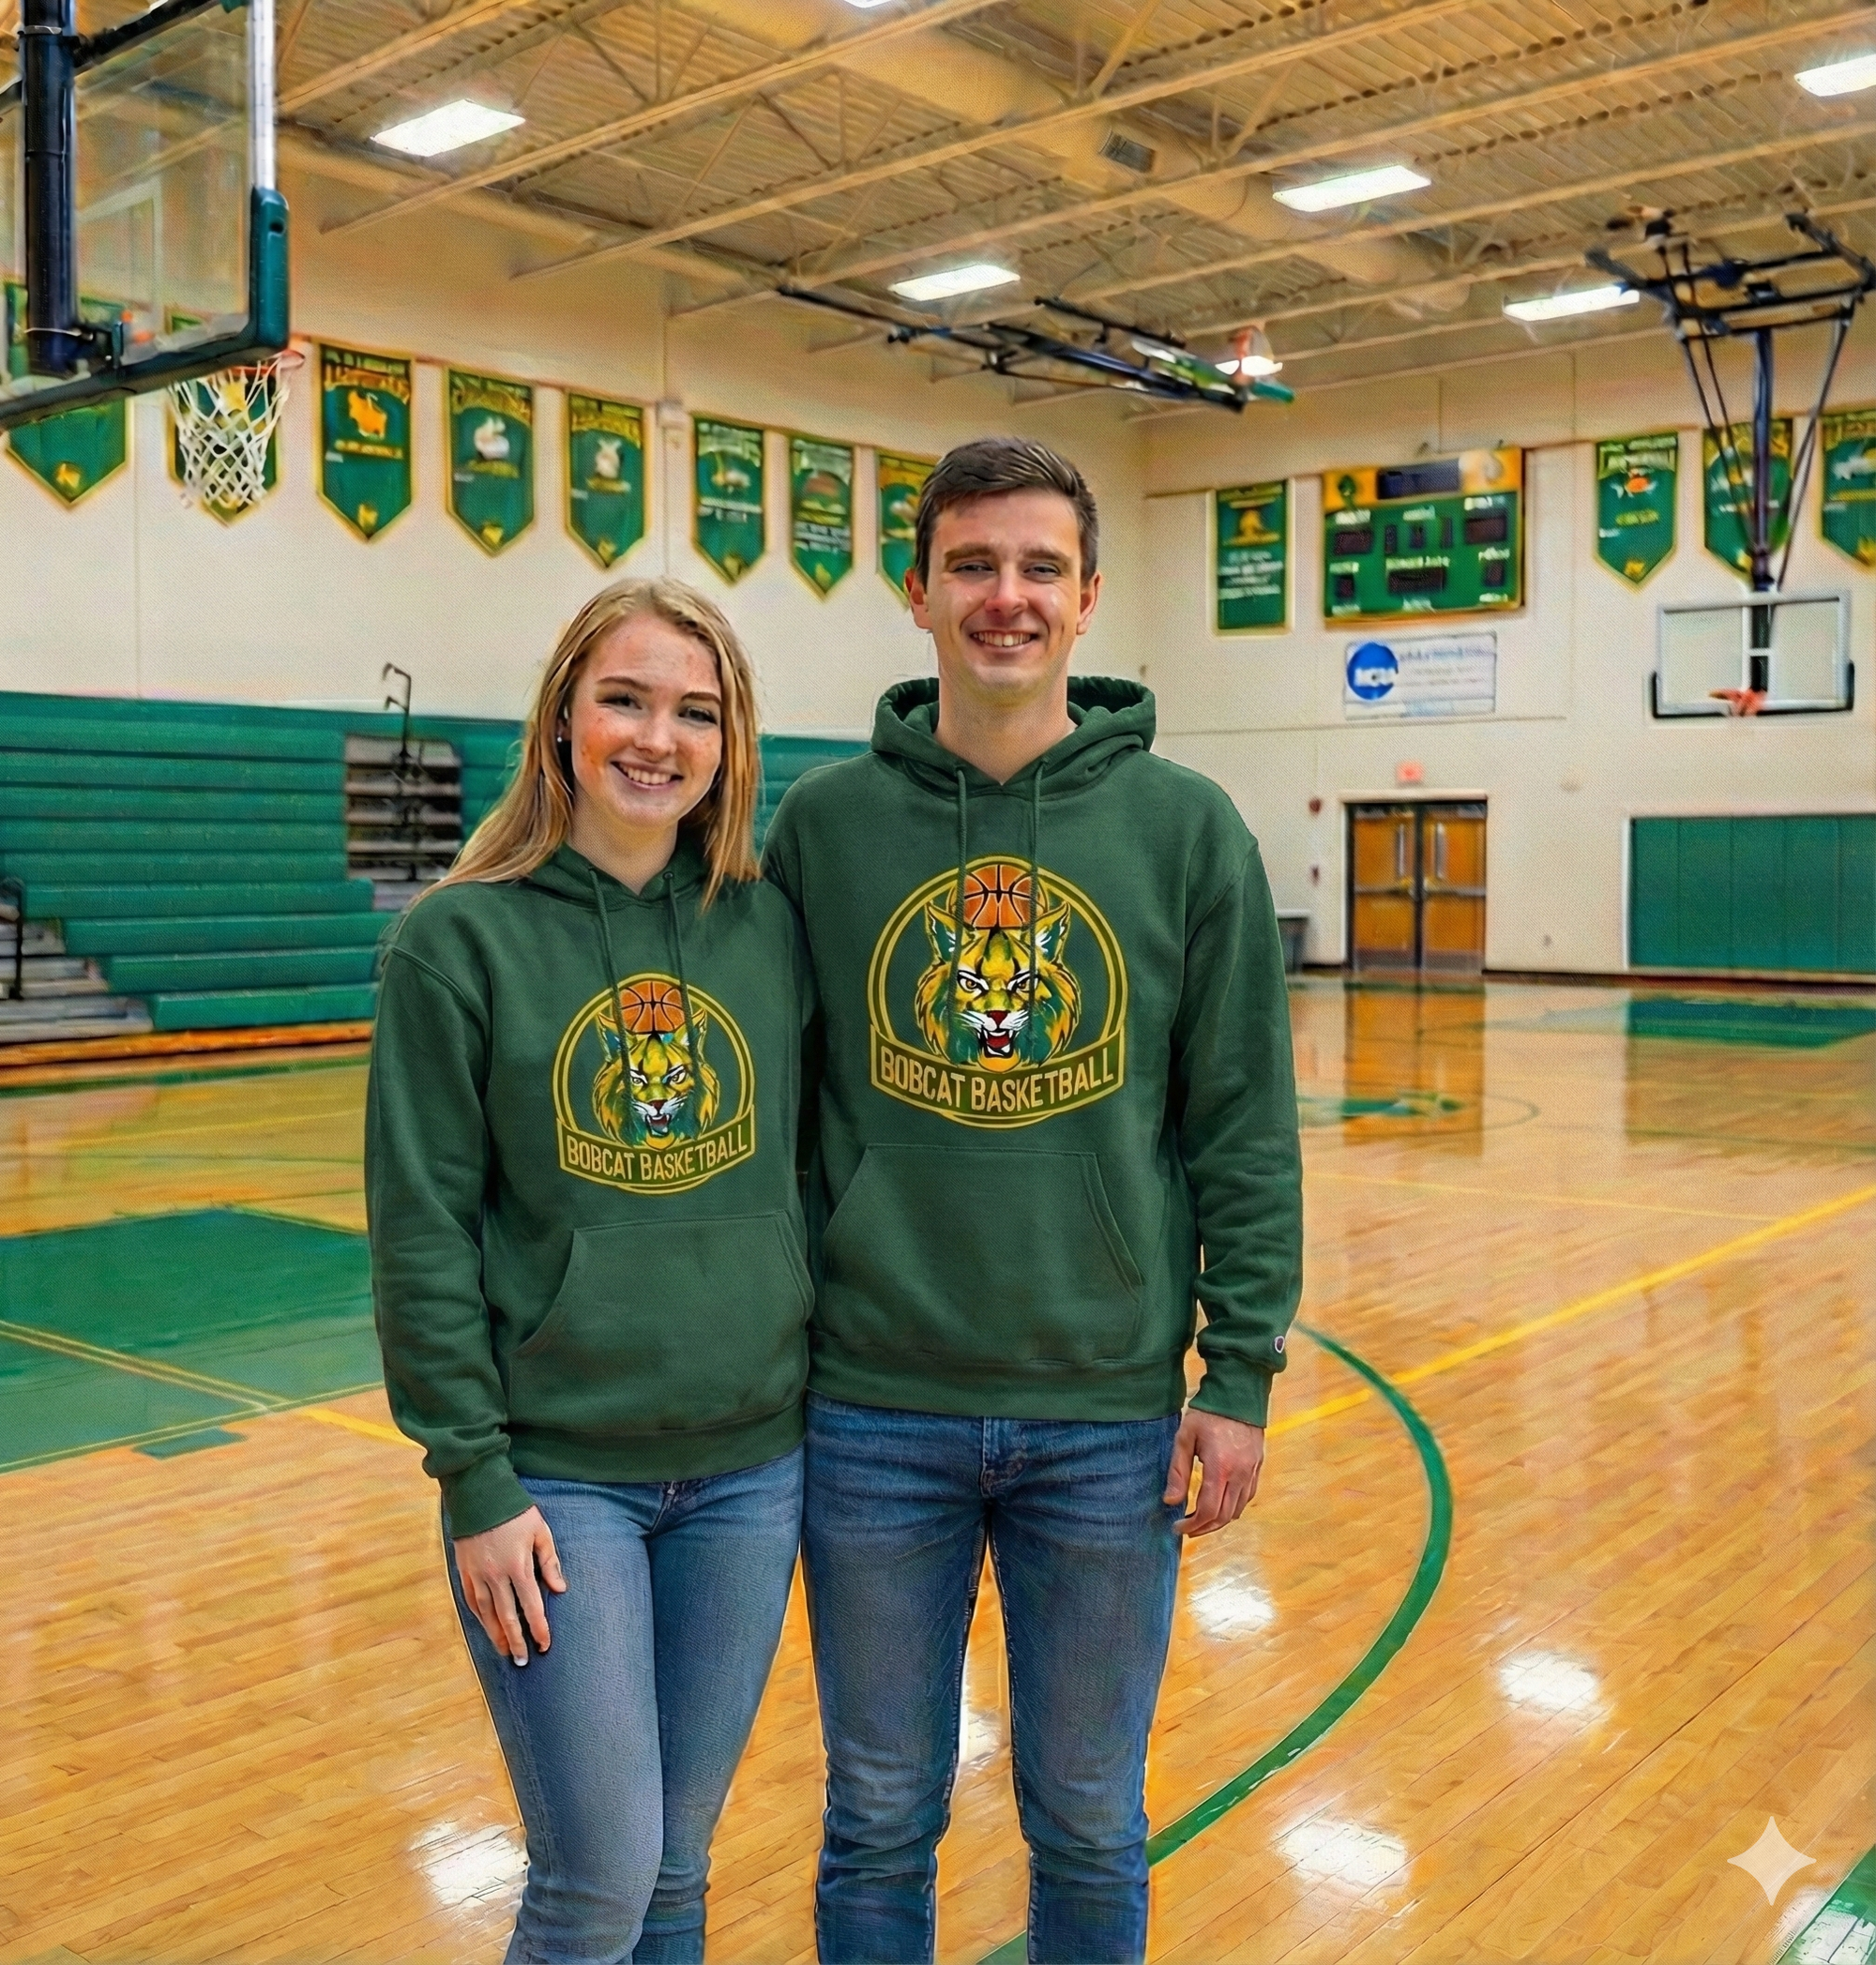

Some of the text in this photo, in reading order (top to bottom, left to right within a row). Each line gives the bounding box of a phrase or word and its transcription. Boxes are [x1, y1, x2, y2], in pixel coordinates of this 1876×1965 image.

[881, 1045, 1113, 1112] BOBCAT BASKETBALL
[567, 1125, 748, 1181] BOBCAT BASKETBALL
